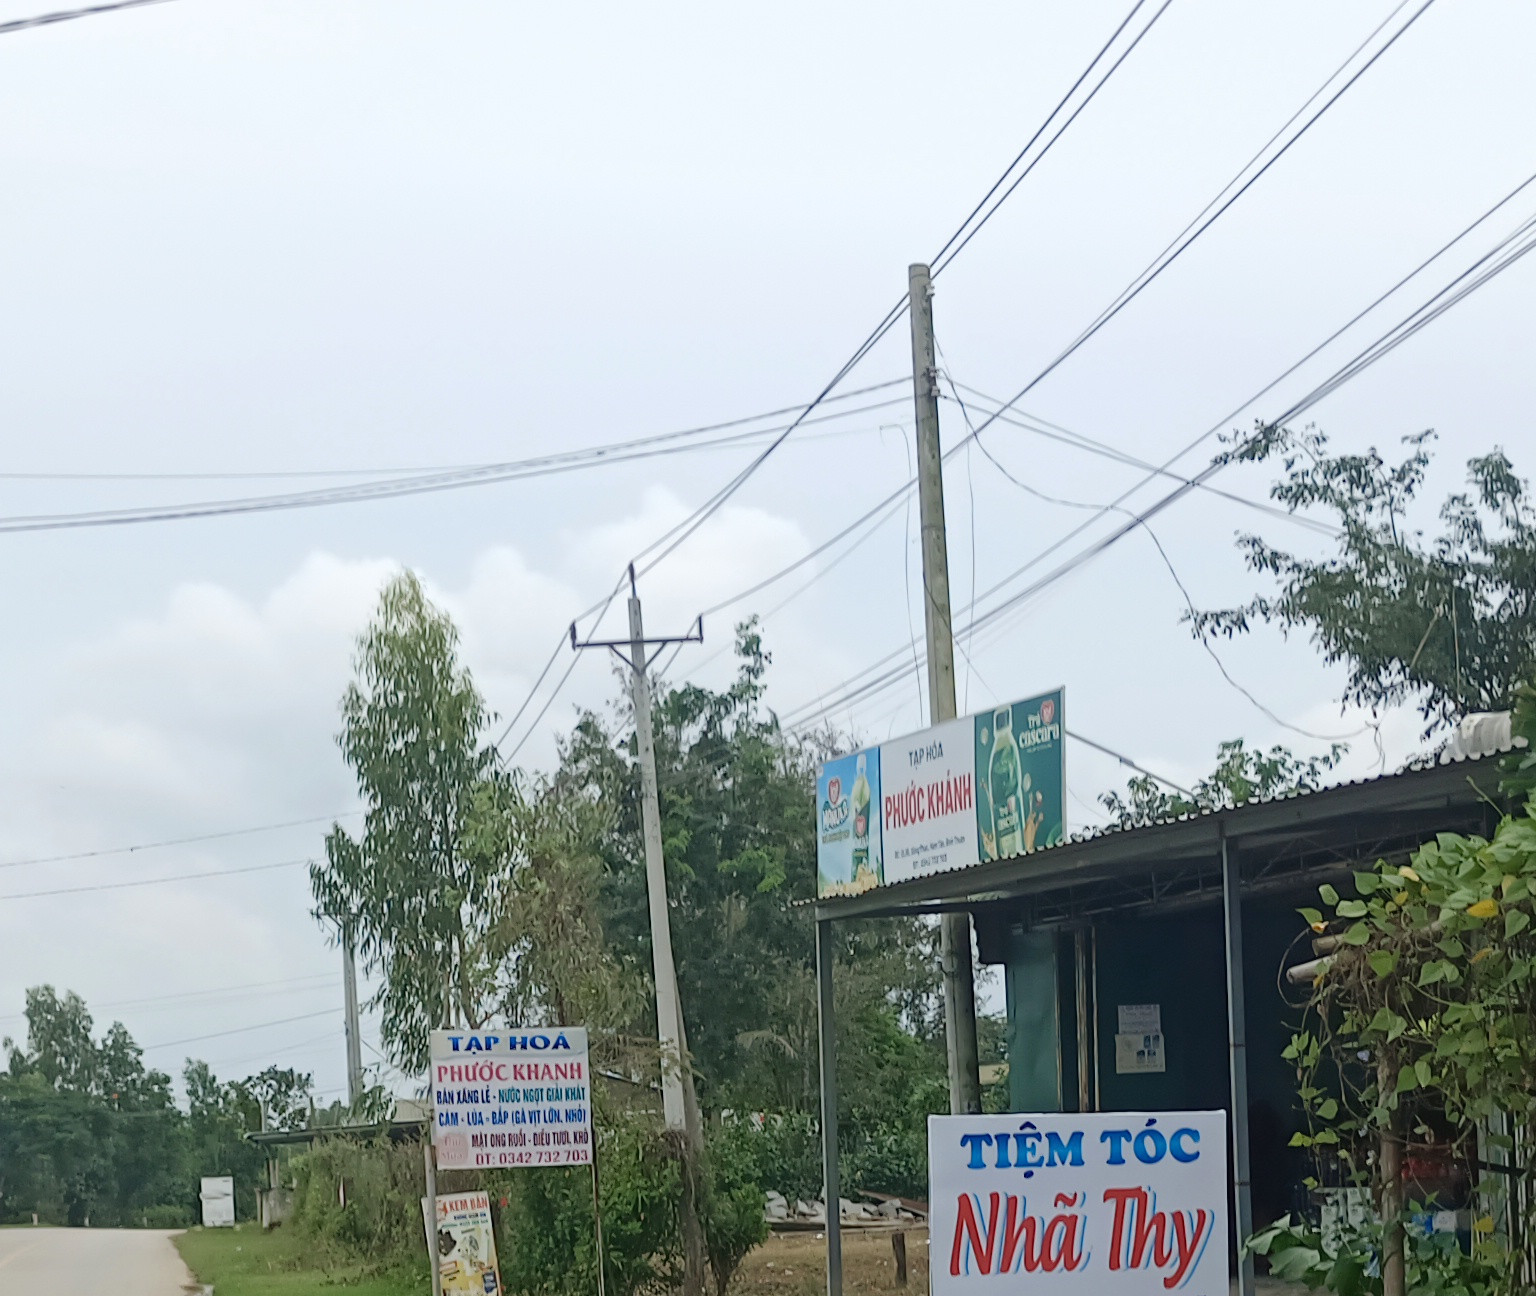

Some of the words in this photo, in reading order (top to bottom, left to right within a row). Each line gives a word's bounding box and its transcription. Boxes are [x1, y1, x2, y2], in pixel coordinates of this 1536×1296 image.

[909, 748, 924, 770] TẠP
[926, 740, 943, 762] HÓA
[885, 780, 925, 831] PHƯỚC
[927, 769, 972, 819] KHÁNH
[448, 1035, 499, 1055] TẠP
[437, 1060, 508, 1083] PHƯỚC
[481, 1085, 491, 1104] LẺ
[498, 1086, 521, 1104] NƯỚC
[523, 1087, 544, 1107] NGỌT
[565, 1084, 586, 1101] KHÁT
[528, 1109, 541, 1127] VỊT
[490, 1133, 506, 1148] ONG
[960, 1121, 1085, 1179] TIỆM
[1100, 1118, 1201, 1165] TÓC
[499, 1151, 533, 1165] 0342
[537, 1150, 561, 1163] 732
[564, 1149, 588, 1162] 703
[950, 1191, 1088, 1277] Nhã
[1103, 1186, 1212, 1289] Thy
